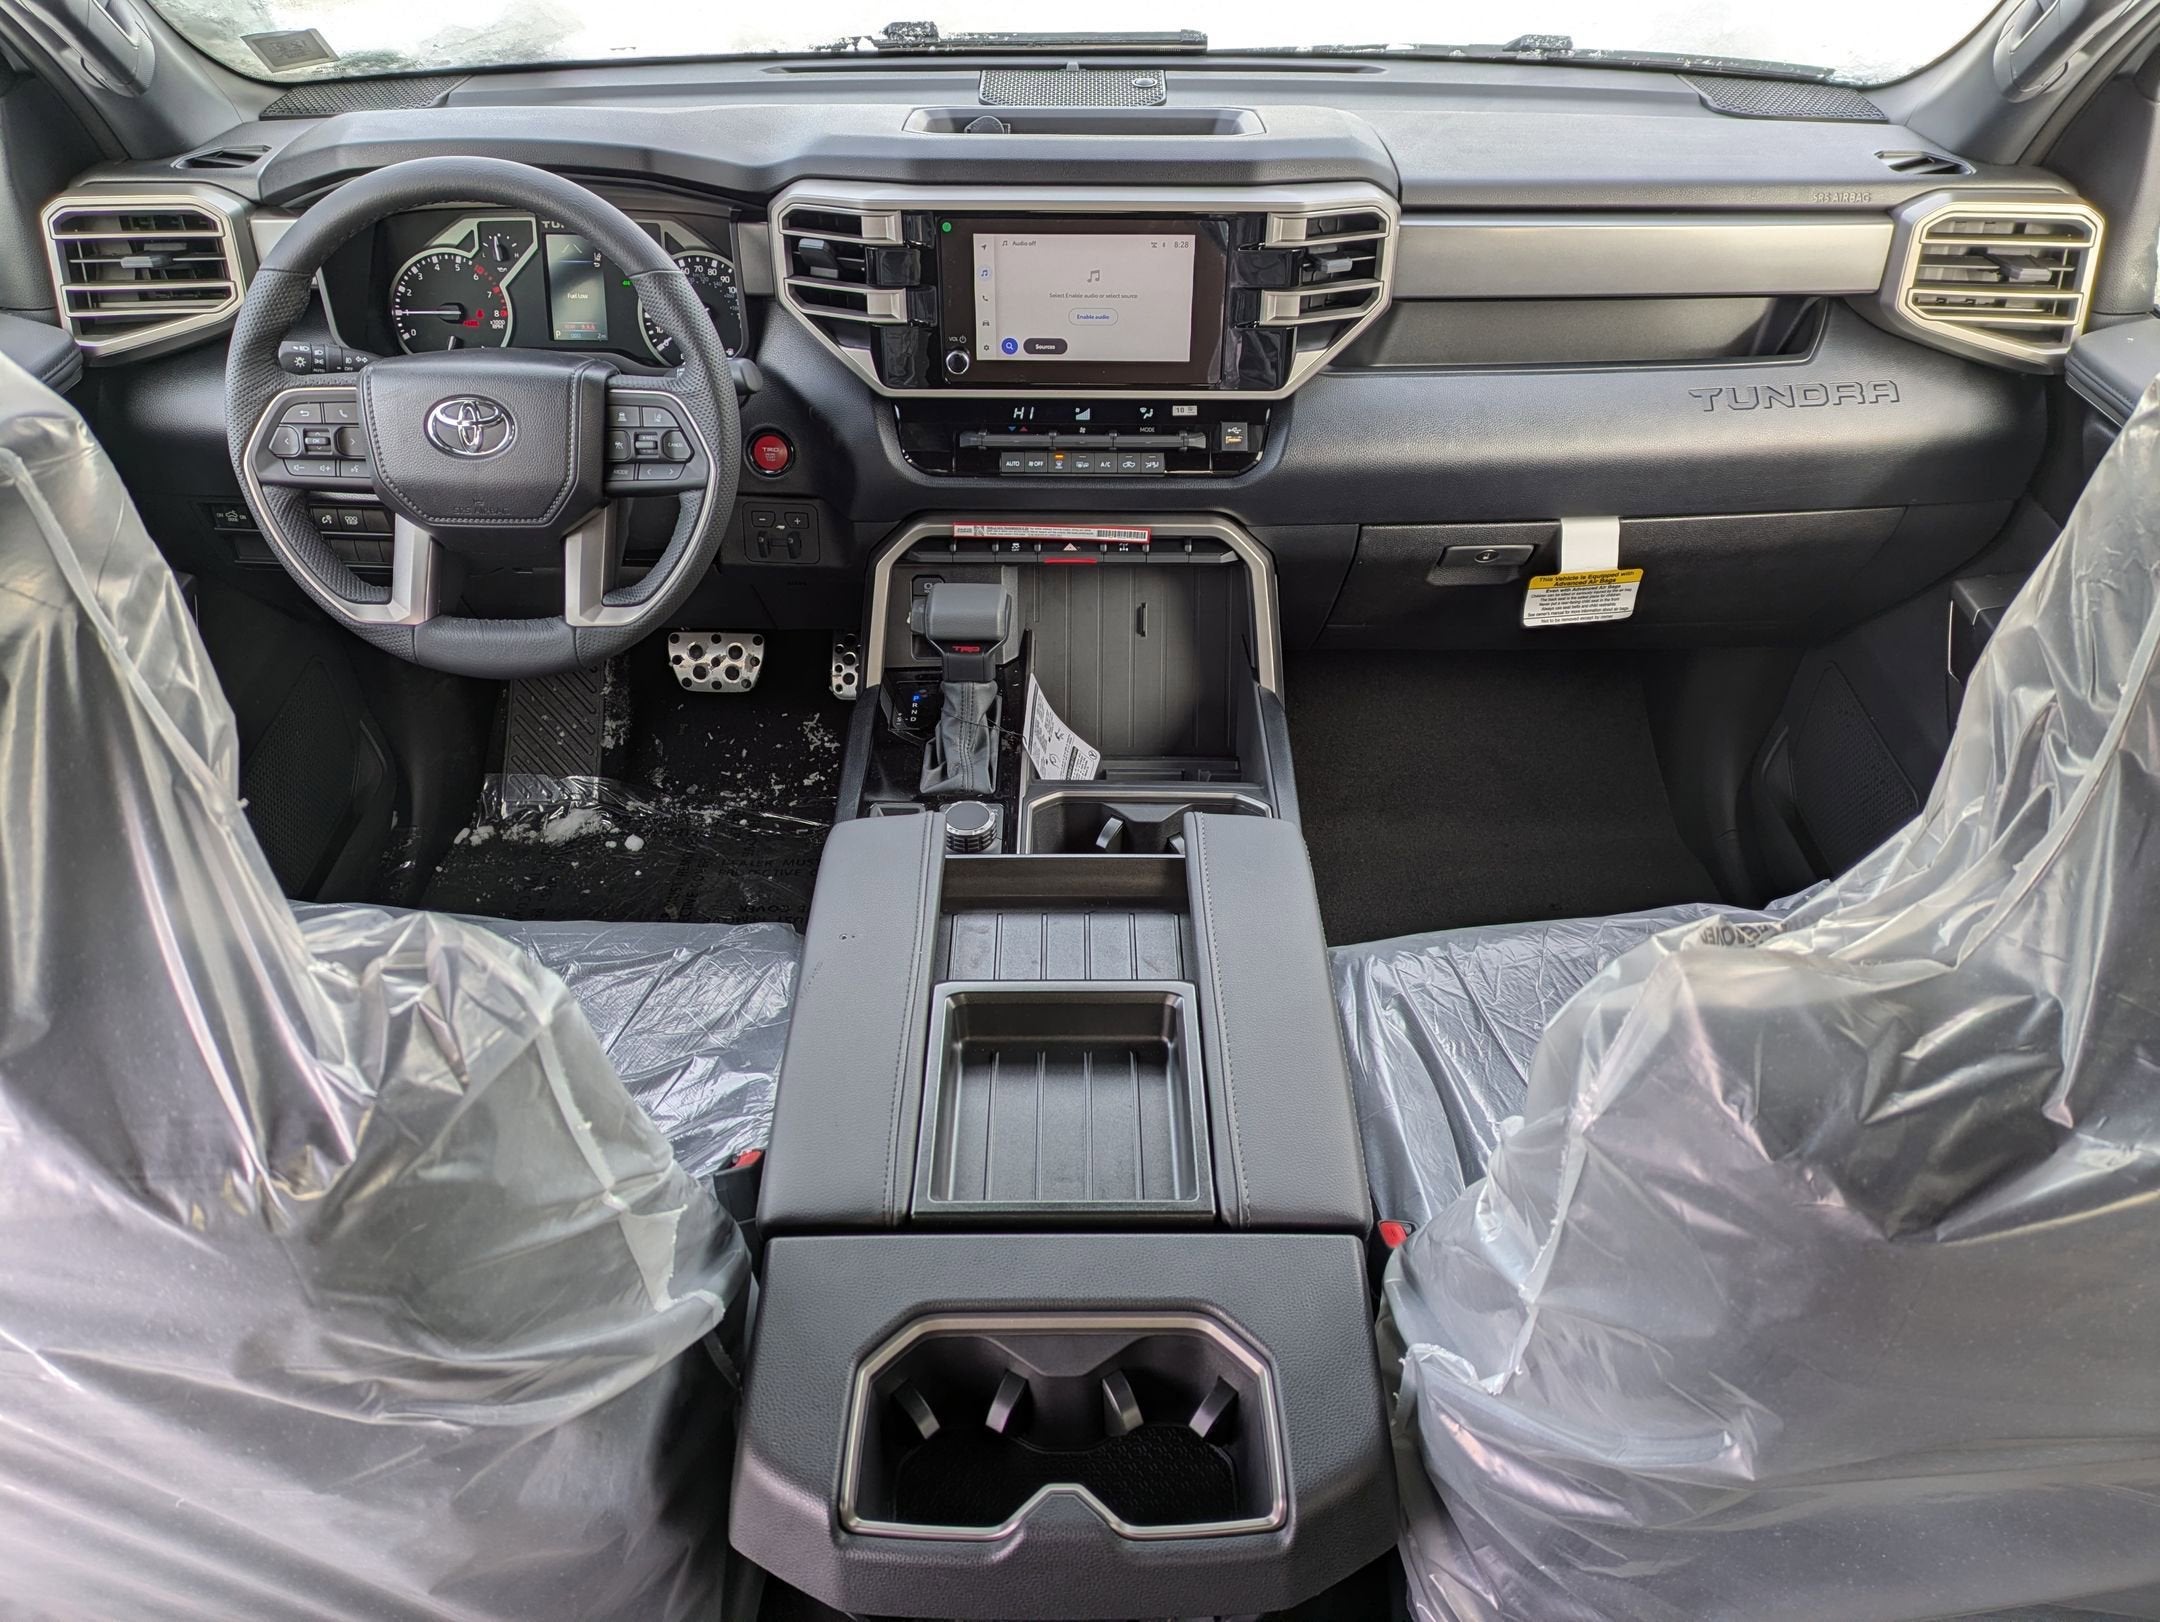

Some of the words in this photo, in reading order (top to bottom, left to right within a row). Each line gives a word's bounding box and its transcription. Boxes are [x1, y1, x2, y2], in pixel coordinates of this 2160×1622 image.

[1812, 192, 1831, 202] SRS
[1832, 192, 1872, 202] AIRBAG
[1174, 241, 1189, 249] 8:28
[455, 264, 461, 272] 5
[694, 265, 704, 273] 70
[707, 268, 718, 276] 80
[417, 272, 423, 280] 3
[720, 276, 731, 284] 90
[555, 330, 561, 339] P
[1688, 380, 1900, 412] TUNDRA
[1588, 572, 1619, 581] Equipped
